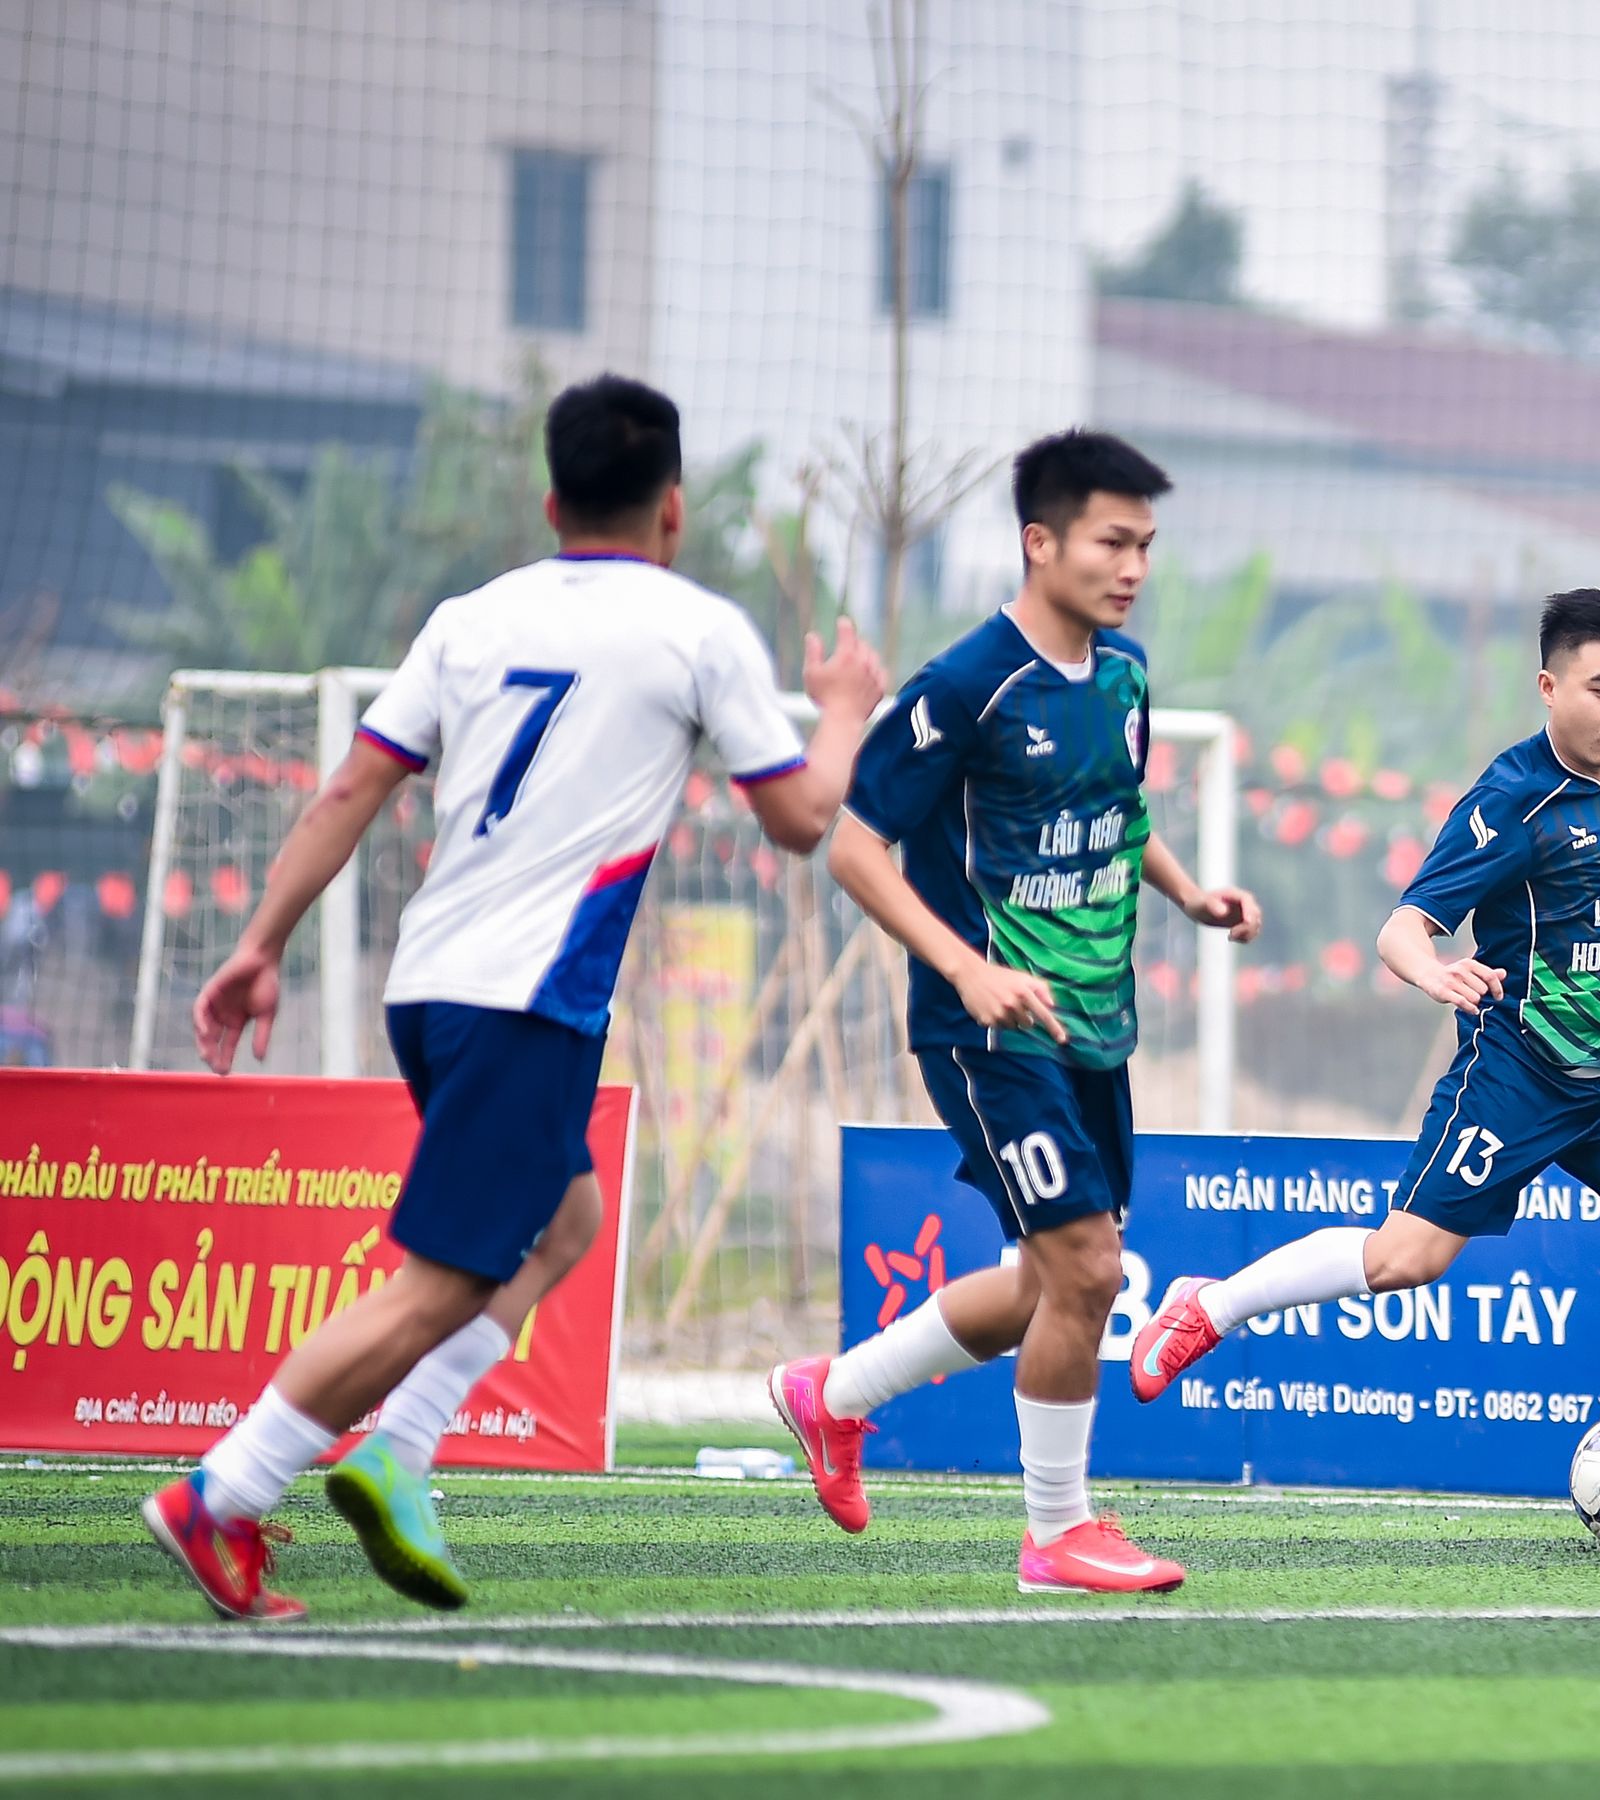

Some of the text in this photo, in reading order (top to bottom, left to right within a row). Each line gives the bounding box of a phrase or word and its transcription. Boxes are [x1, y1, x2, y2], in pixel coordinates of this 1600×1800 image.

[473, 668, 581, 840] 7
[61, 1144, 117, 1200] ĐẦU
[121, 1158, 156, 1202] TƯ
[154, 1155, 222, 1204] PHÁT
[296, 1165, 402, 1209] THƯƠNG
[1000, 1131, 1068, 1205] 10
[1446, 1124, 1504, 1187] 13
[1185, 1168, 1275, 1212] NGÂN
[1283, 1170, 1373, 1214] HÀNG
[0, 1229, 134, 1372] ỘNG
[141, 1227, 256, 1352] SẢN
[1466, 1269, 1577, 1345] TÂY
[1181, 1378, 1219, 1409] Mr.
[1225, 1376, 1273, 1411] Cấn
[1279, 1381, 1328, 1418] Việt
[1333, 1383, 1415, 1423] Dương
[1435, 1388, 1478, 1418] ĐT:
[1484, 1390, 1543, 1421] 0862
[1548, 1393, 1593, 1423] 967
